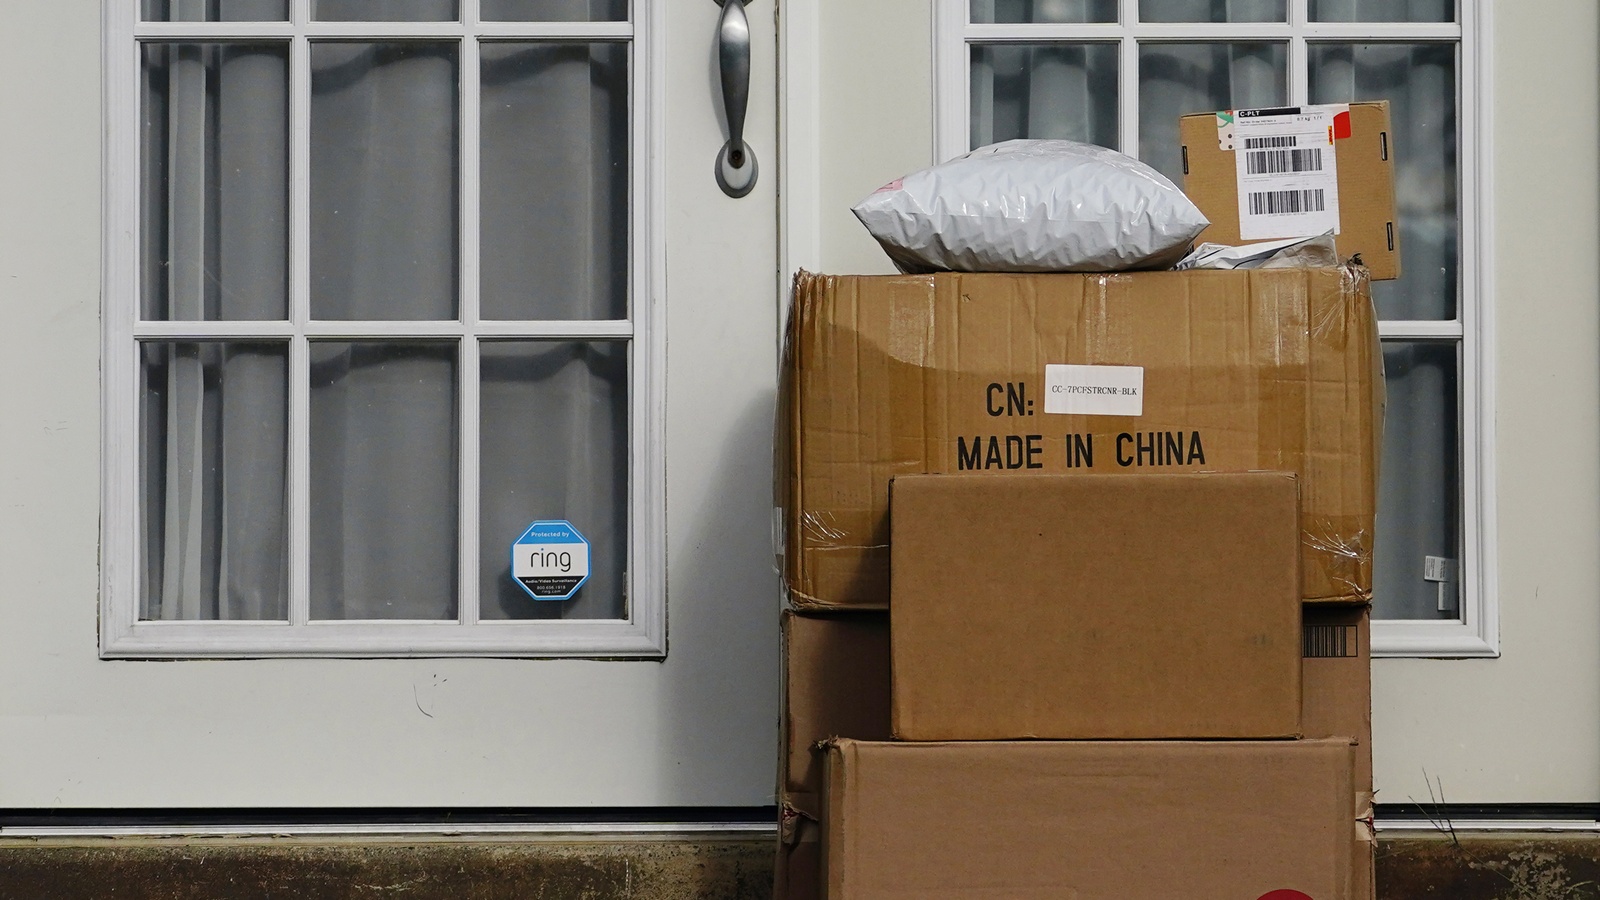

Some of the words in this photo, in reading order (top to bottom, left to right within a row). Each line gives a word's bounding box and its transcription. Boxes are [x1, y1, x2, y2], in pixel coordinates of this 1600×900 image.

[986, 382, 1034, 417] CN:
[1051, 385, 1137, 396] CC-7PCFSTRCNR-BLK
[957, 434, 1043, 471] MADE
[1066, 433, 1093, 468] IN
[1116, 431, 1206, 467] CHINA
[530, 548, 571, 573] ring
